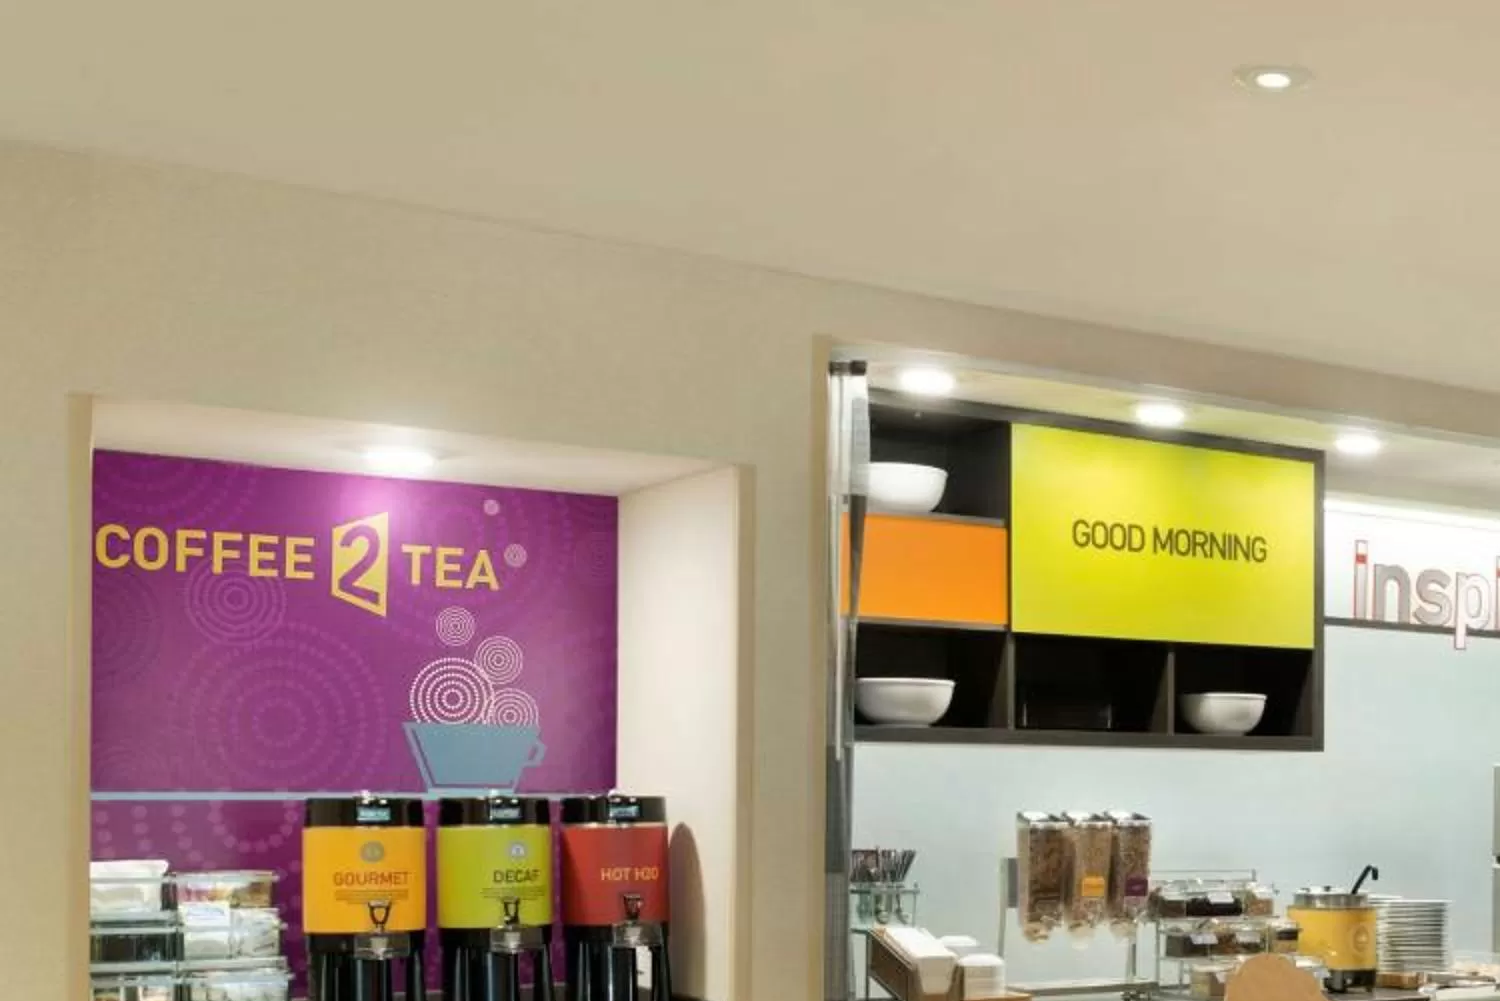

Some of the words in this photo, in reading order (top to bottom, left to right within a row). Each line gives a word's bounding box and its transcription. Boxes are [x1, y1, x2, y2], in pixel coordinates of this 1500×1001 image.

[1071, 518, 1146, 553] GOOD
[1152, 525, 1268, 563] MORNING
[94, 523, 316, 580] COFFEE
[336, 522, 383, 608] 2
[400, 543, 500, 591] TEA
[332, 871, 409, 886] GOURMET
[493, 869, 541, 884] DECAF
[600, 868, 631, 881] HOT
